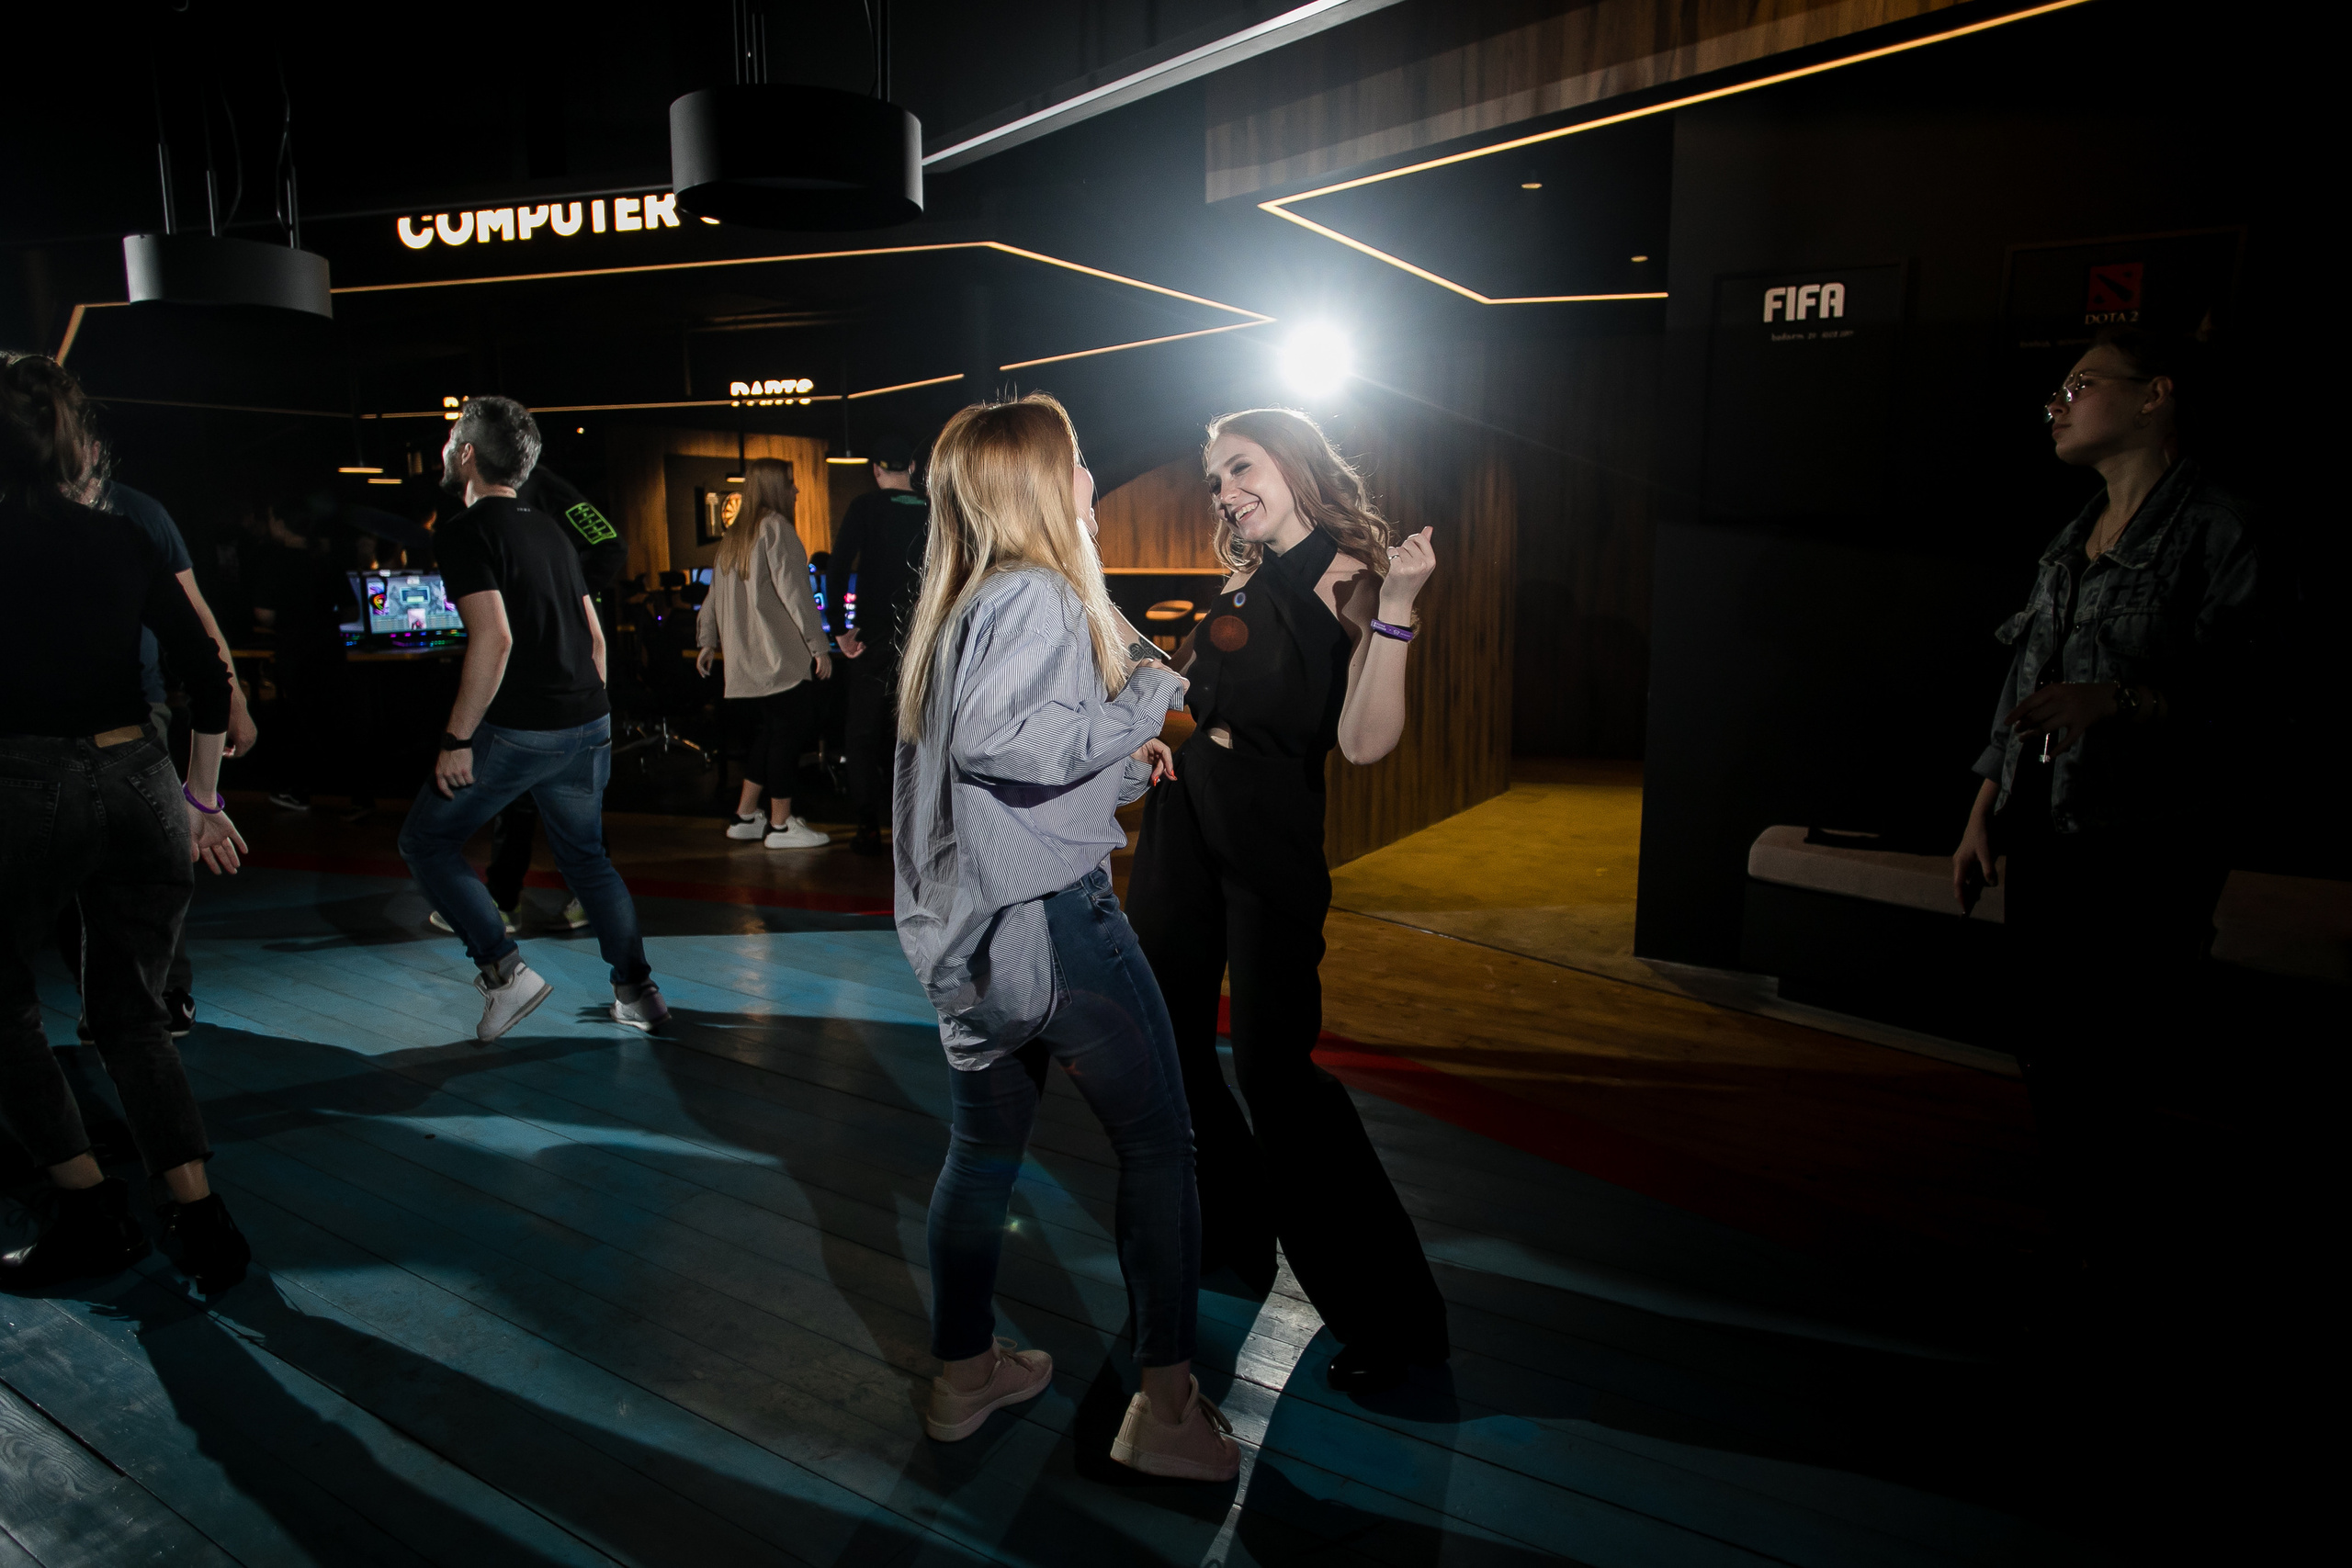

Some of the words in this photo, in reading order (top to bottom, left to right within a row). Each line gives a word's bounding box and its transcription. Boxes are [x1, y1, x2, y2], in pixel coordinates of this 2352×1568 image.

[1763, 282, 1846, 323] FIFA
[2085, 311, 2127, 326] DOTA
[2129, 310, 2140, 323] 2
